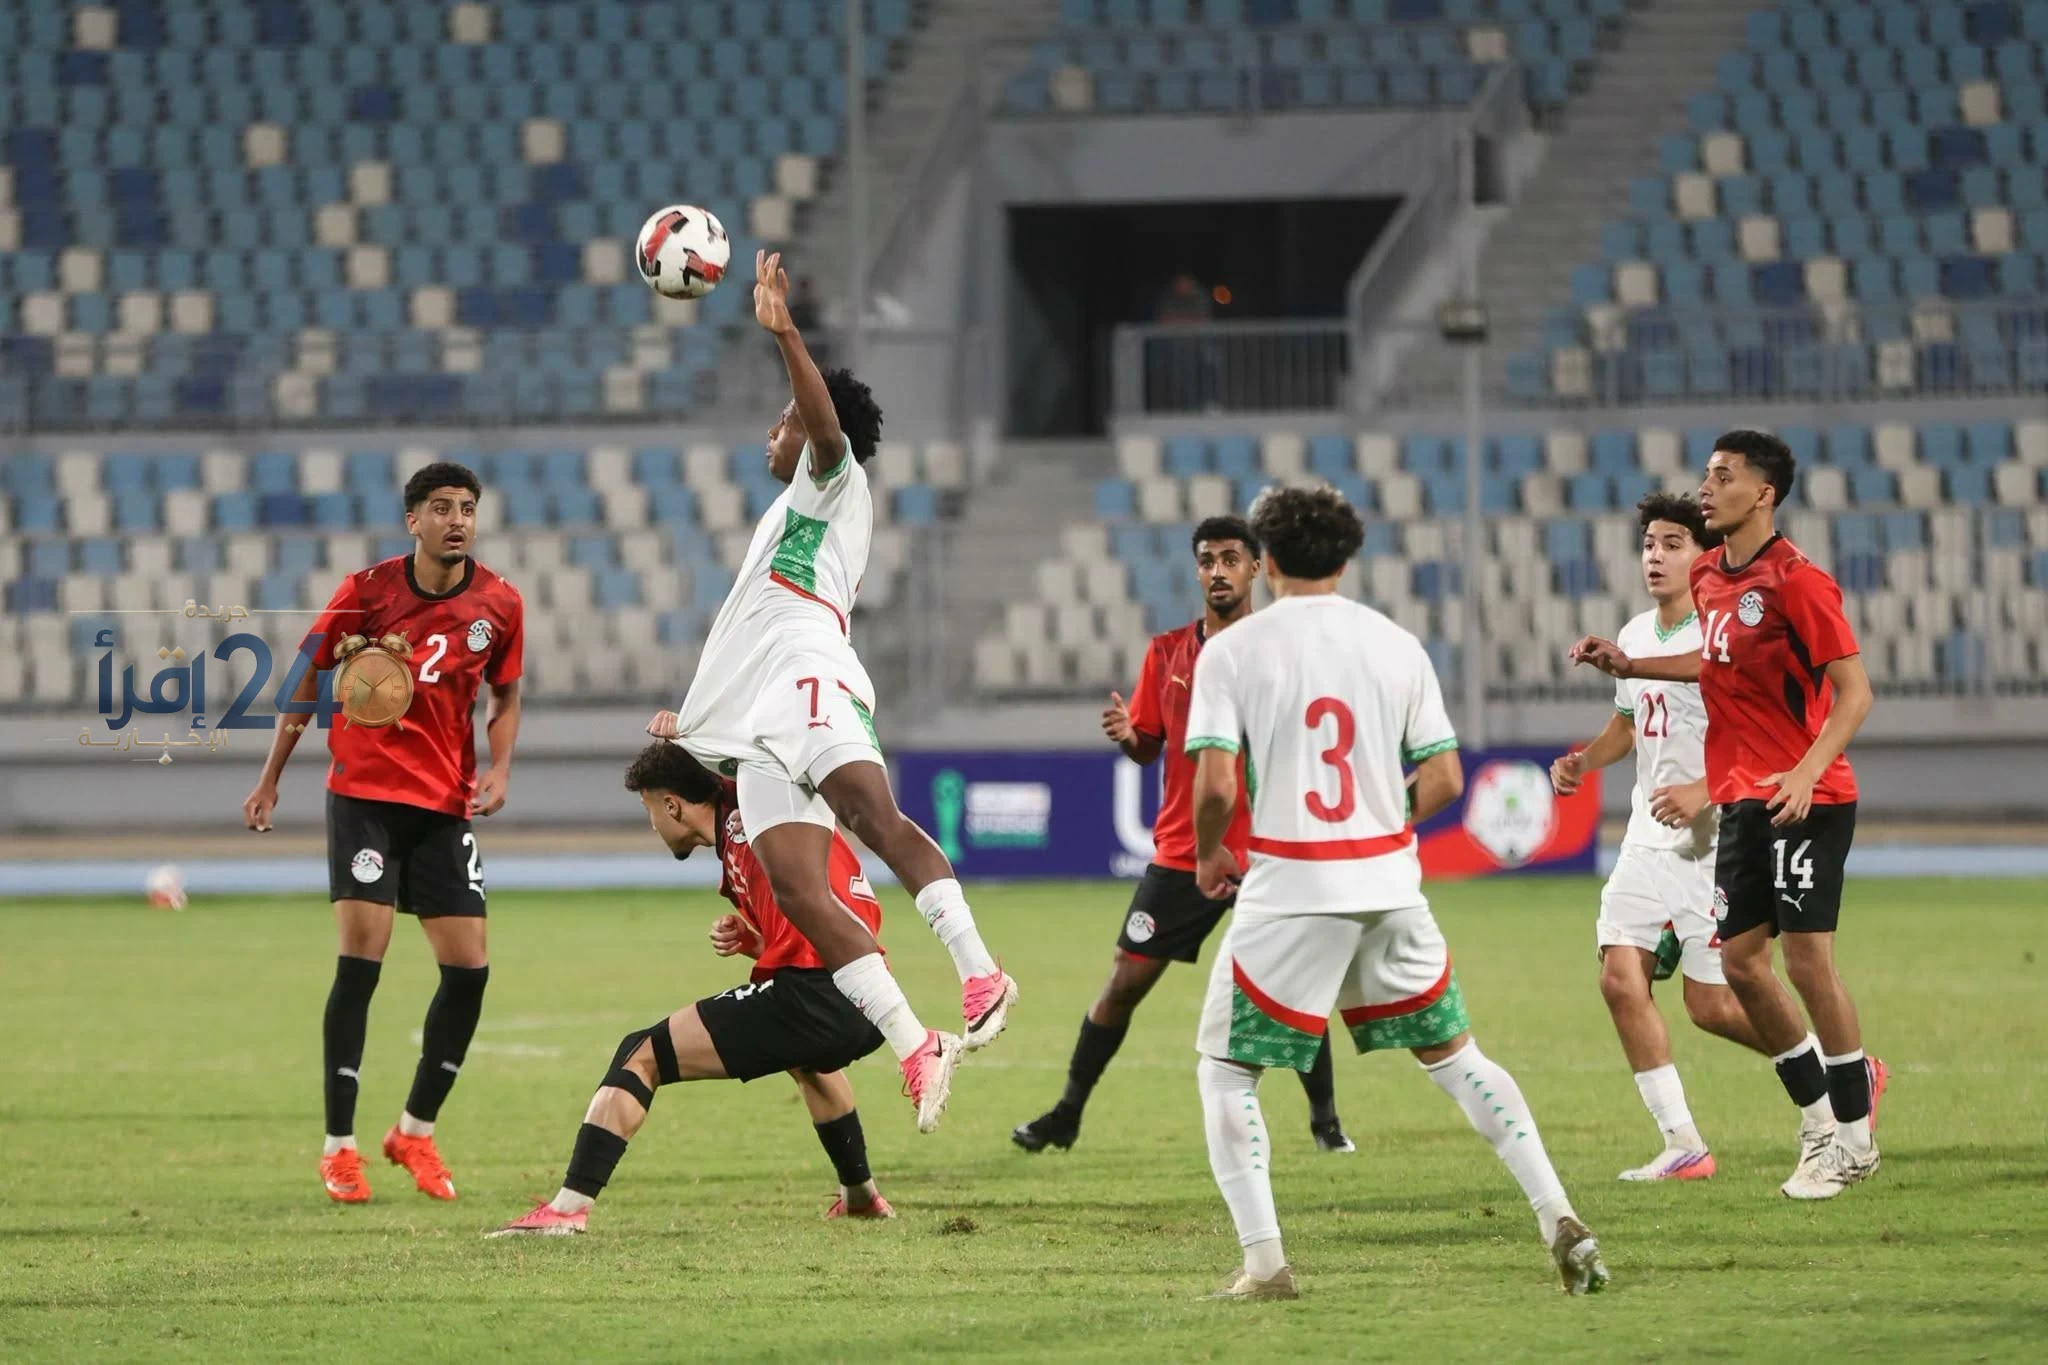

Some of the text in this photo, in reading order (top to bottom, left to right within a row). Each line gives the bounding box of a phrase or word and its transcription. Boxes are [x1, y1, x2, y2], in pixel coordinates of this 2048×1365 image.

[418, 633, 447, 683] 2
[1701, 609, 1732, 663] 14
[796, 677, 819, 718] 7
[1641, 692, 1669, 738] 21
[1304, 696, 1356, 823] 3
[462, 832, 483, 881] 2
[1773, 839, 1814, 889] 14
